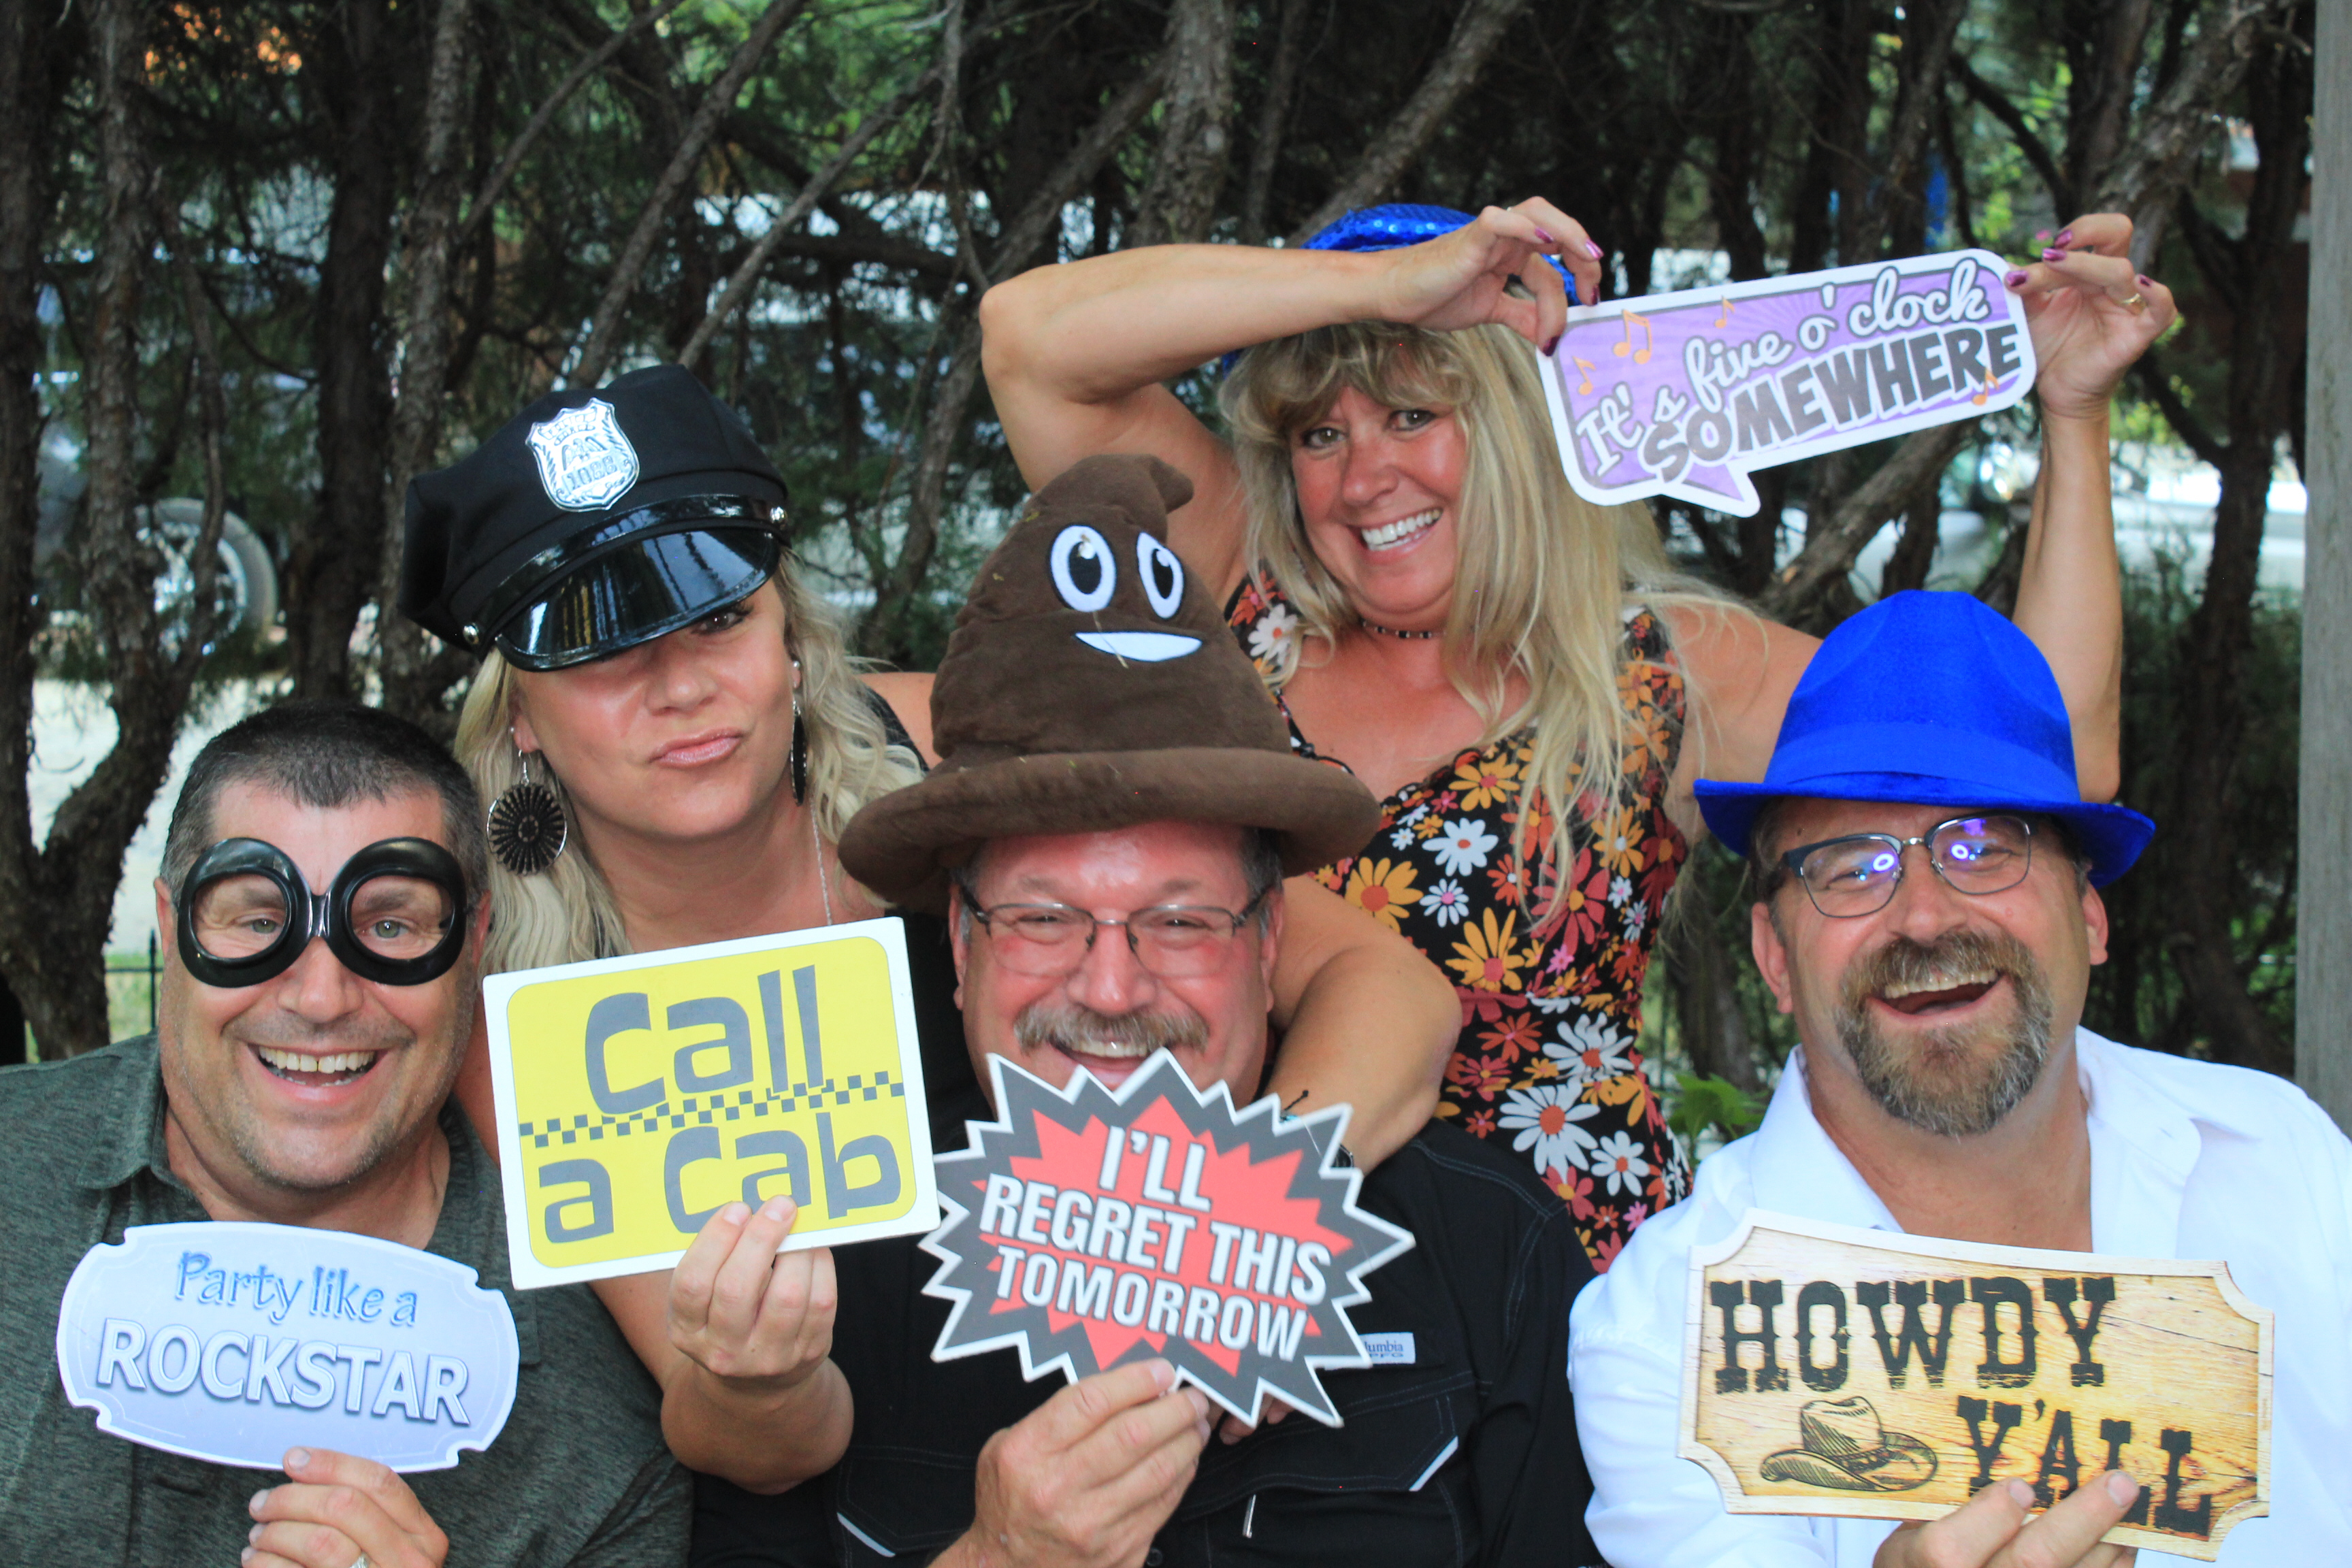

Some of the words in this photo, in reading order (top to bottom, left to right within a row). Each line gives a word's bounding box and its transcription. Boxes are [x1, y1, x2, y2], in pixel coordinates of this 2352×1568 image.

[1577, 383, 1686, 477] It's
[1684, 331, 1793, 411] five
[1798, 257, 1989, 350] o'clock
[1641, 322, 2023, 483] SOMEWHERE
[538, 1158, 615, 1244] a
[1098, 1124, 1213, 1212] I'LL
[175, 1251, 304, 1326] Party
[309, 1265, 385, 1322] like
[390, 1290, 419, 1327] a
[978, 1173, 1197, 1275] REGRET
[1209, 1220, 1332, 1305] THIS
[995, 1244, 1309, 1362] TOMORROW
[1364, 1340, 1404, 1352] lumbia
[1709, 1275, 2116, 1394] HOWDY
[96, 1317, 470, 1426] ROCKSTAR
